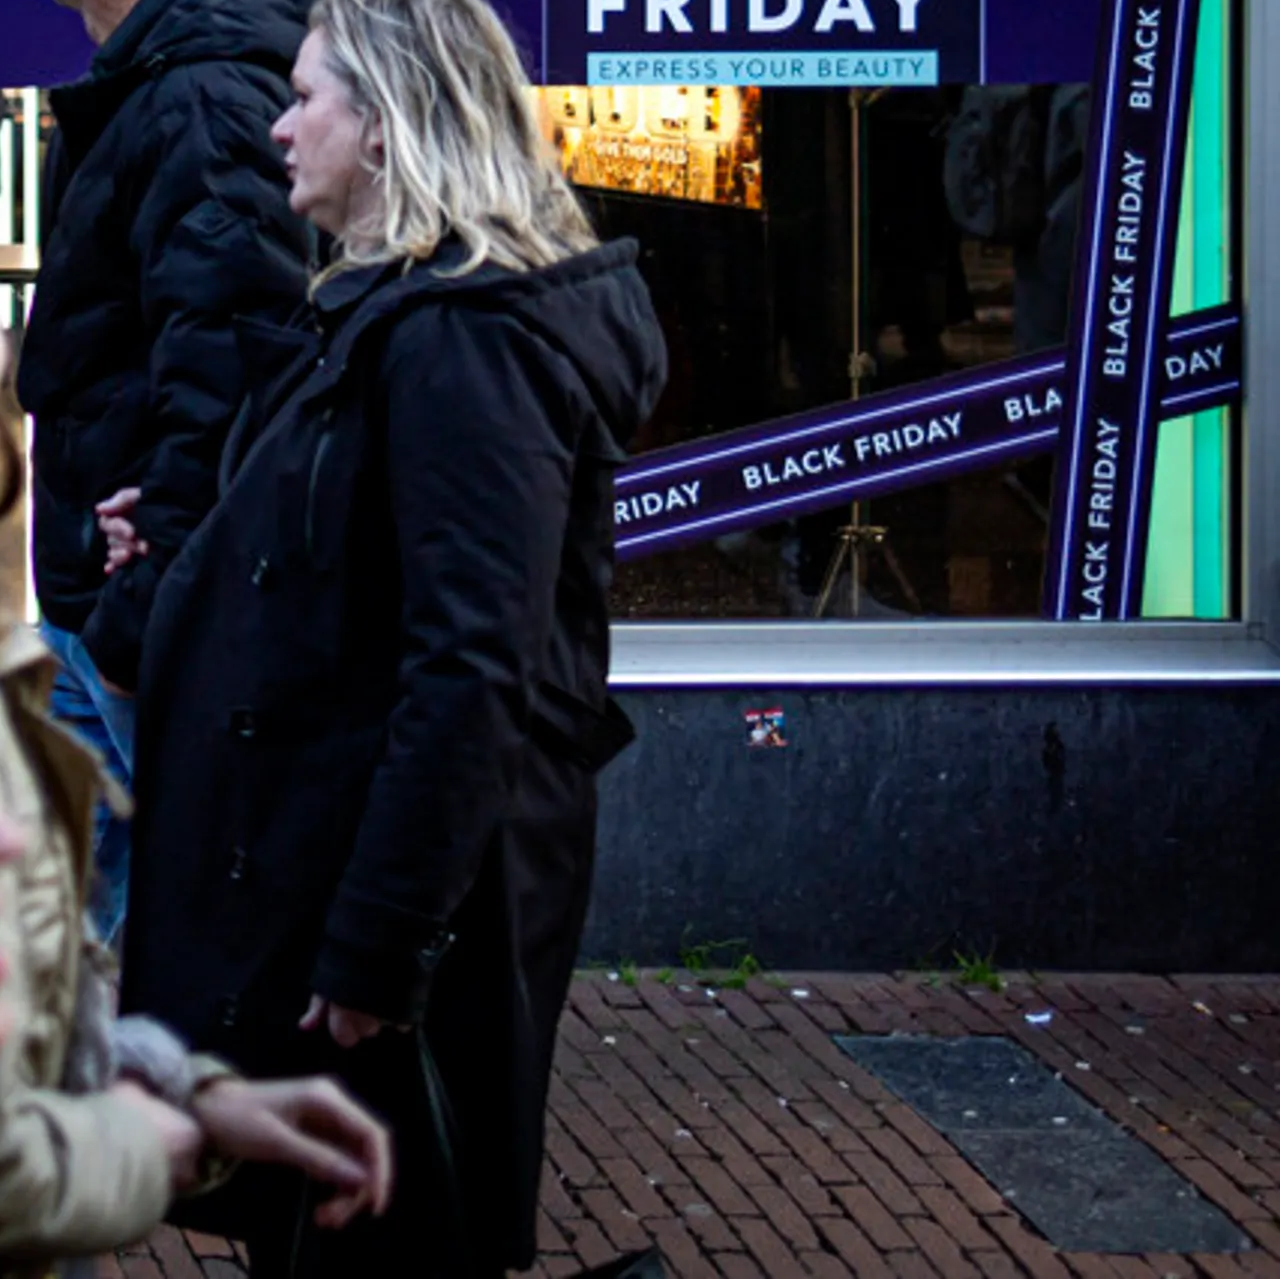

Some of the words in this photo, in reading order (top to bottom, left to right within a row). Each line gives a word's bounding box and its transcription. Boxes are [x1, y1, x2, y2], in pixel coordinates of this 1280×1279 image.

[599, 58, 718, 79] EXPRESS
[729, 57, 805, 78] YOUR
[817, 57, 924, 78] BEAUTY
[1129, 8, 1161, 109] BLACK
[1114, 151, 1147, 263] FRIDAY
[1103, 275, 1136, 376] BLACK
[1003, 388, 1062, 422] BLA
[1165, 343, 1225, 381] DAY
[742, 444, 845, 490] BLACK
[854, 413, 963, 462] FRIDAY
[1088, 418, 1120, 529] FRIDAY
[614, 481, 702, 523] RIDAY
[1079, 541, 1110, 620] LACK
